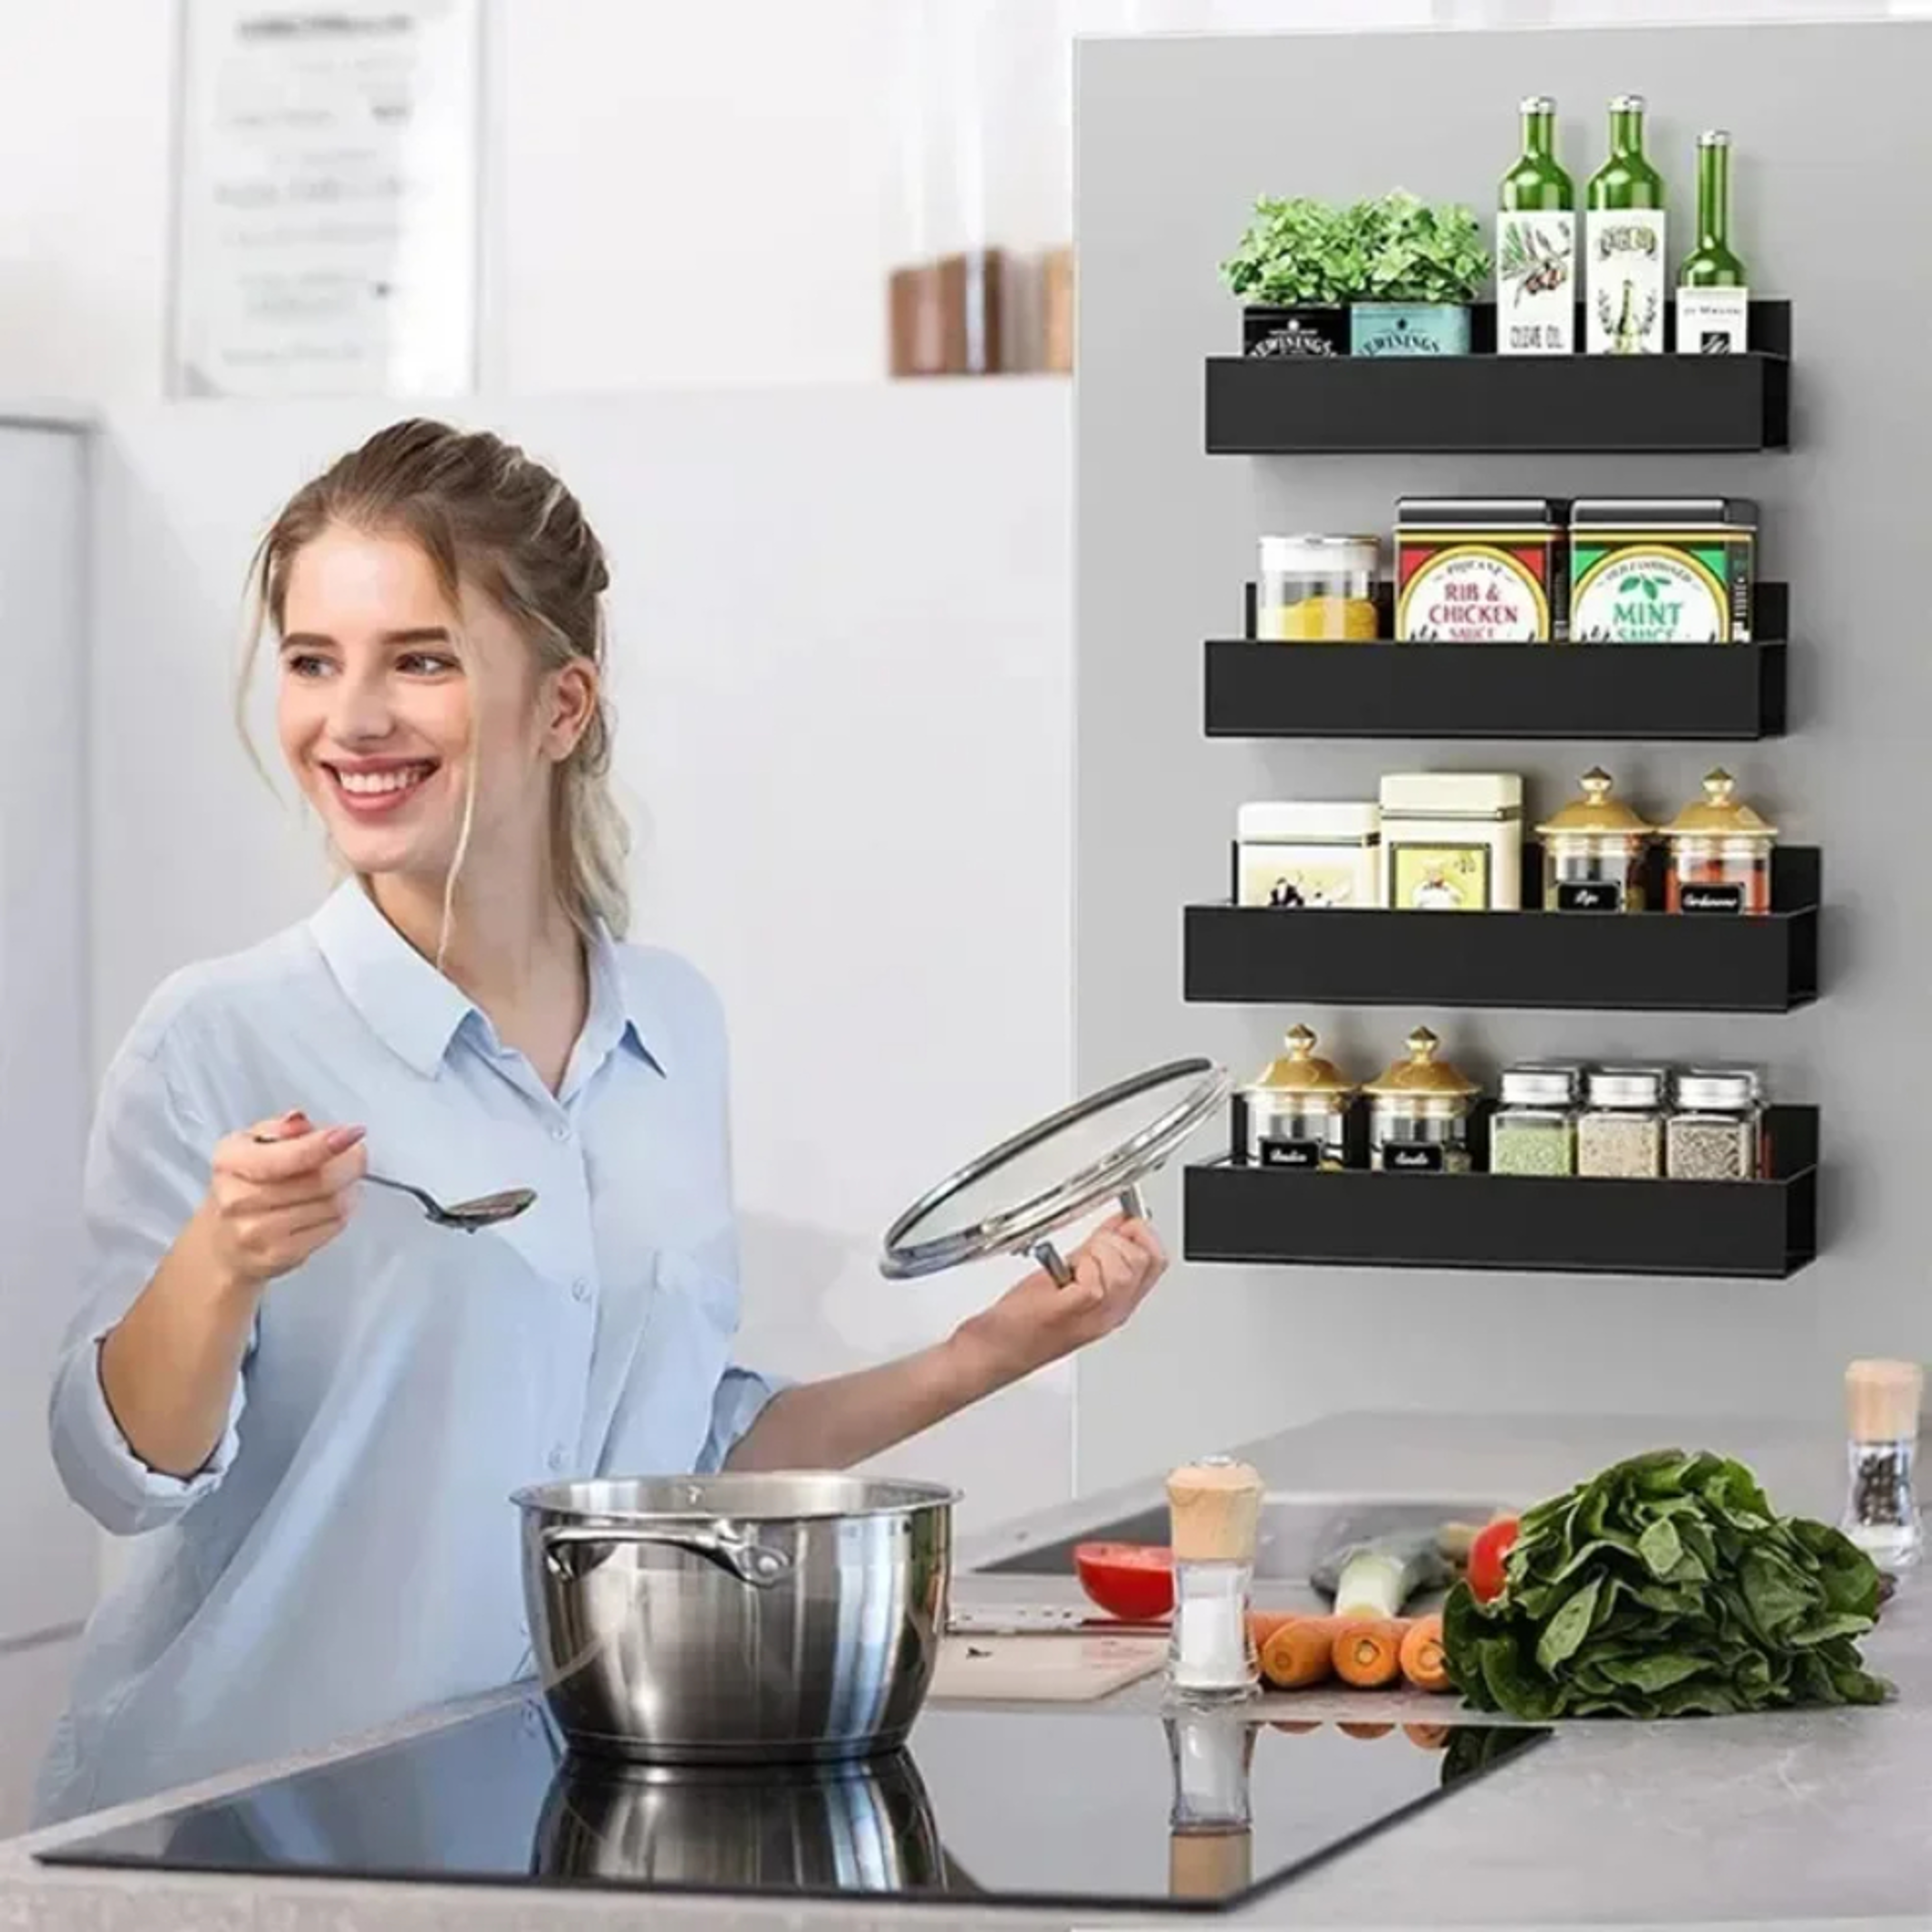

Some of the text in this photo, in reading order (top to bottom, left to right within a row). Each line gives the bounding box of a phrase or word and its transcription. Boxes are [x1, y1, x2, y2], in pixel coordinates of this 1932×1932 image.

[1444, 582, 1501, 602] RIB &
[1427, 604, 1518, 624] CHICKEN
[1612, 601, 1684, 626] MINT
